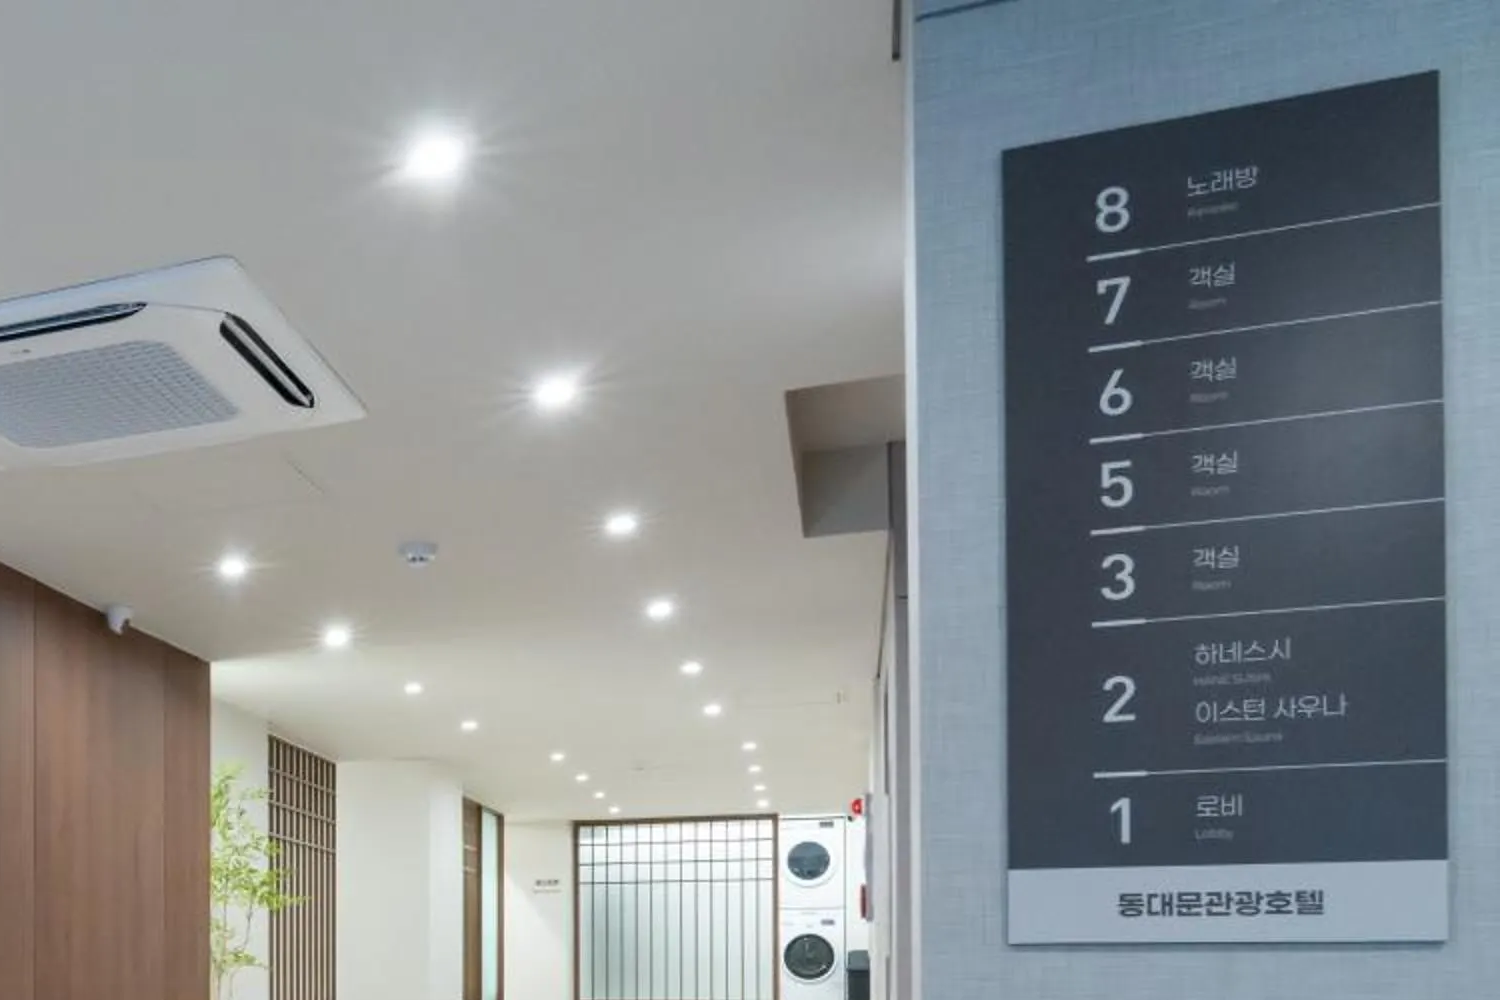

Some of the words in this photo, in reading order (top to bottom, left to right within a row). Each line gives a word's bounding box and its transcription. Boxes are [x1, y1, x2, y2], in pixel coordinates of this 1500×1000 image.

[1187, 166, 1259, 197] 노래방
[1095, 185, 1130, 233] 8
[1189, 262, 1237, 287] 객실
[1096, 275, 1131, 325] 7
[1190, 357, 1238, 382] 객실
[1099, 368, 1134, 416] 6
[1191, 451, 1239, 475] 객실
[1100, 460, 1134, 508] 5
[1192, 546, 1241, 569] 객실
[1100, 553, 1136, 600] 3
[1194, 638, 1292, 666] 하네스시
[1102, 675, 1137, 723] 2
[1195, 698, 1266, 723] 이스턴
[1272, 693, 1348, 719] 사우나
[1196, 794, 1243, 817] 로비
[1109, 797, 1132, 845] 1
[1116, 890, 1325, 918] 동대문관광호텔
